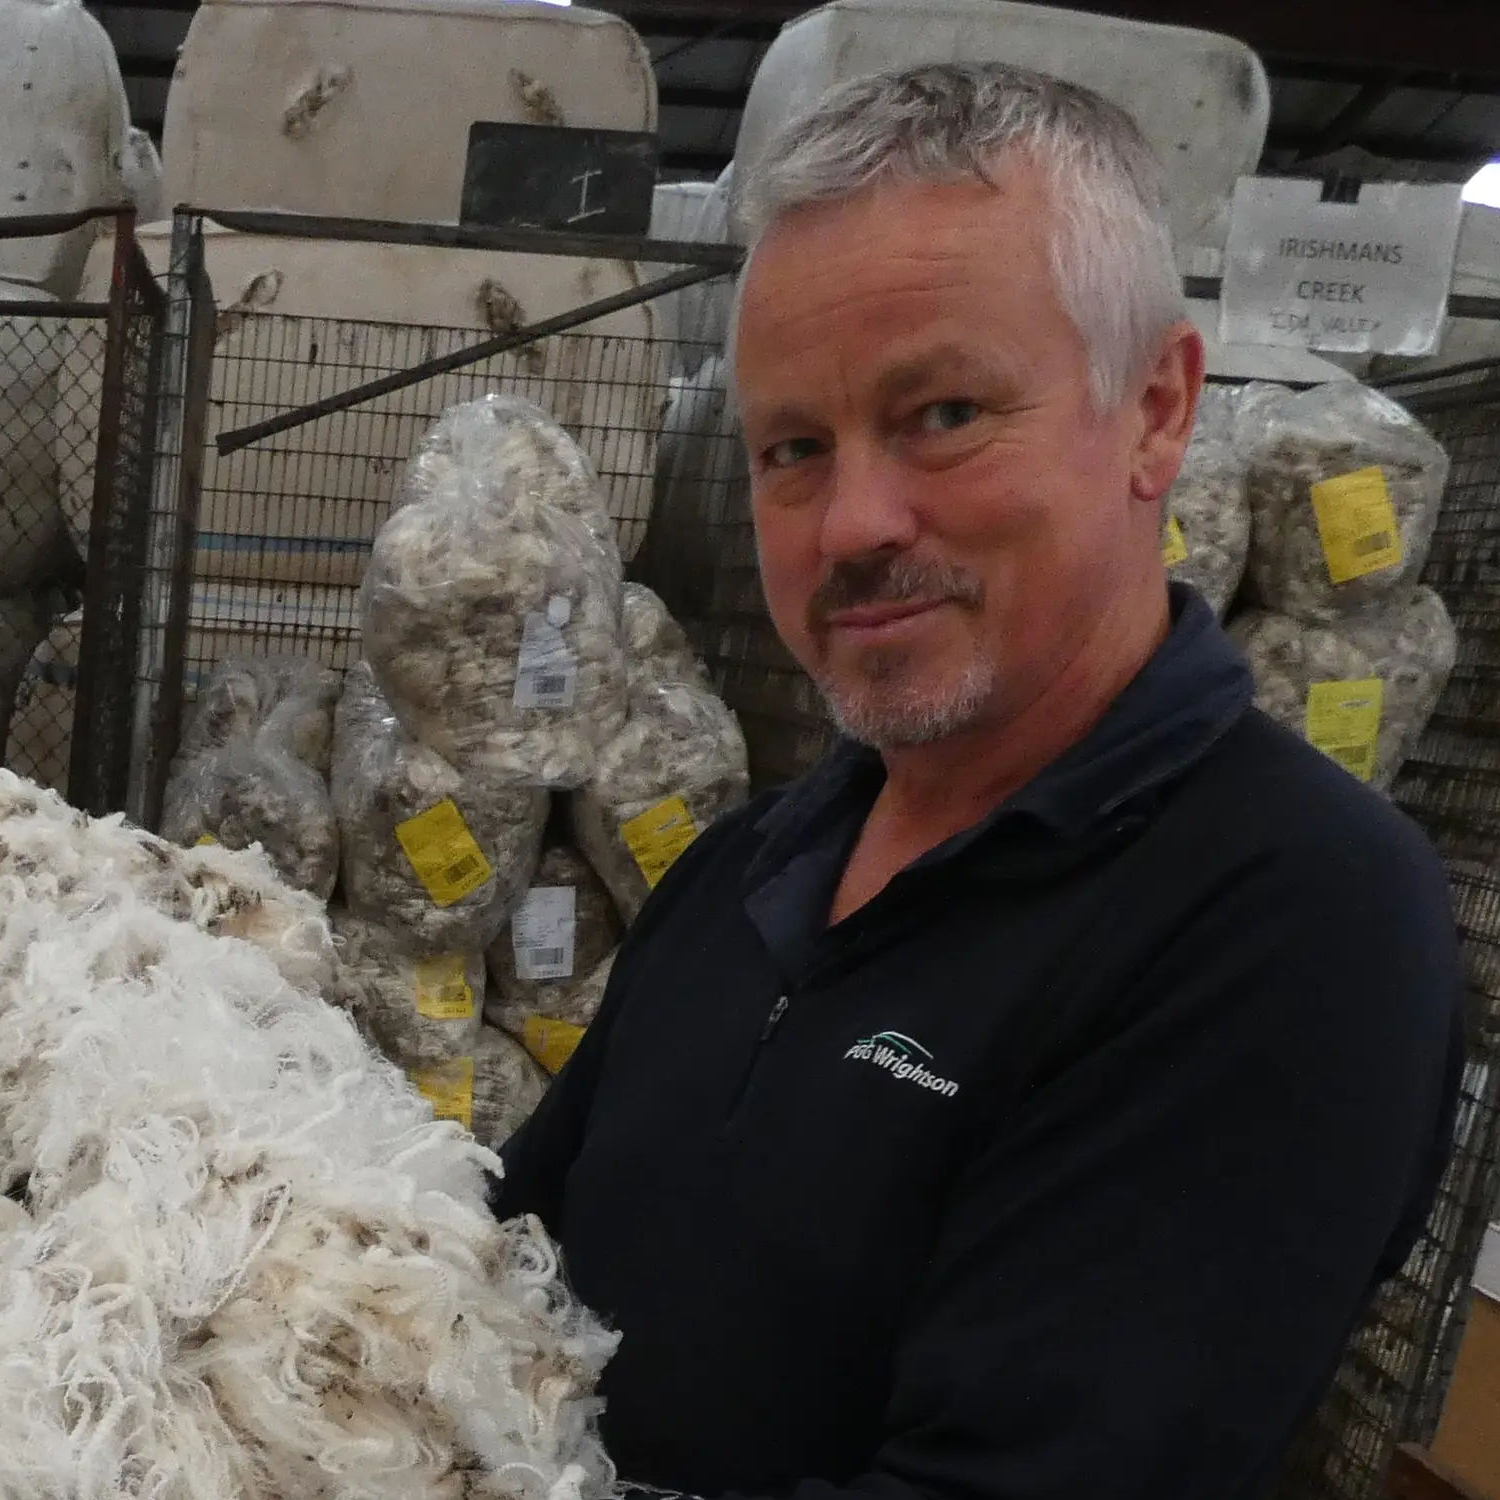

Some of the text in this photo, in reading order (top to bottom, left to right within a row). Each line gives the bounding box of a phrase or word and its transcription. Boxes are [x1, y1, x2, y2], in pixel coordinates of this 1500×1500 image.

[1278, 237, 1403, 264] IRISHMANS
[1297, 280, 1366, 303] CREEK
[871, 1044, 959, 1097] Wrightson
